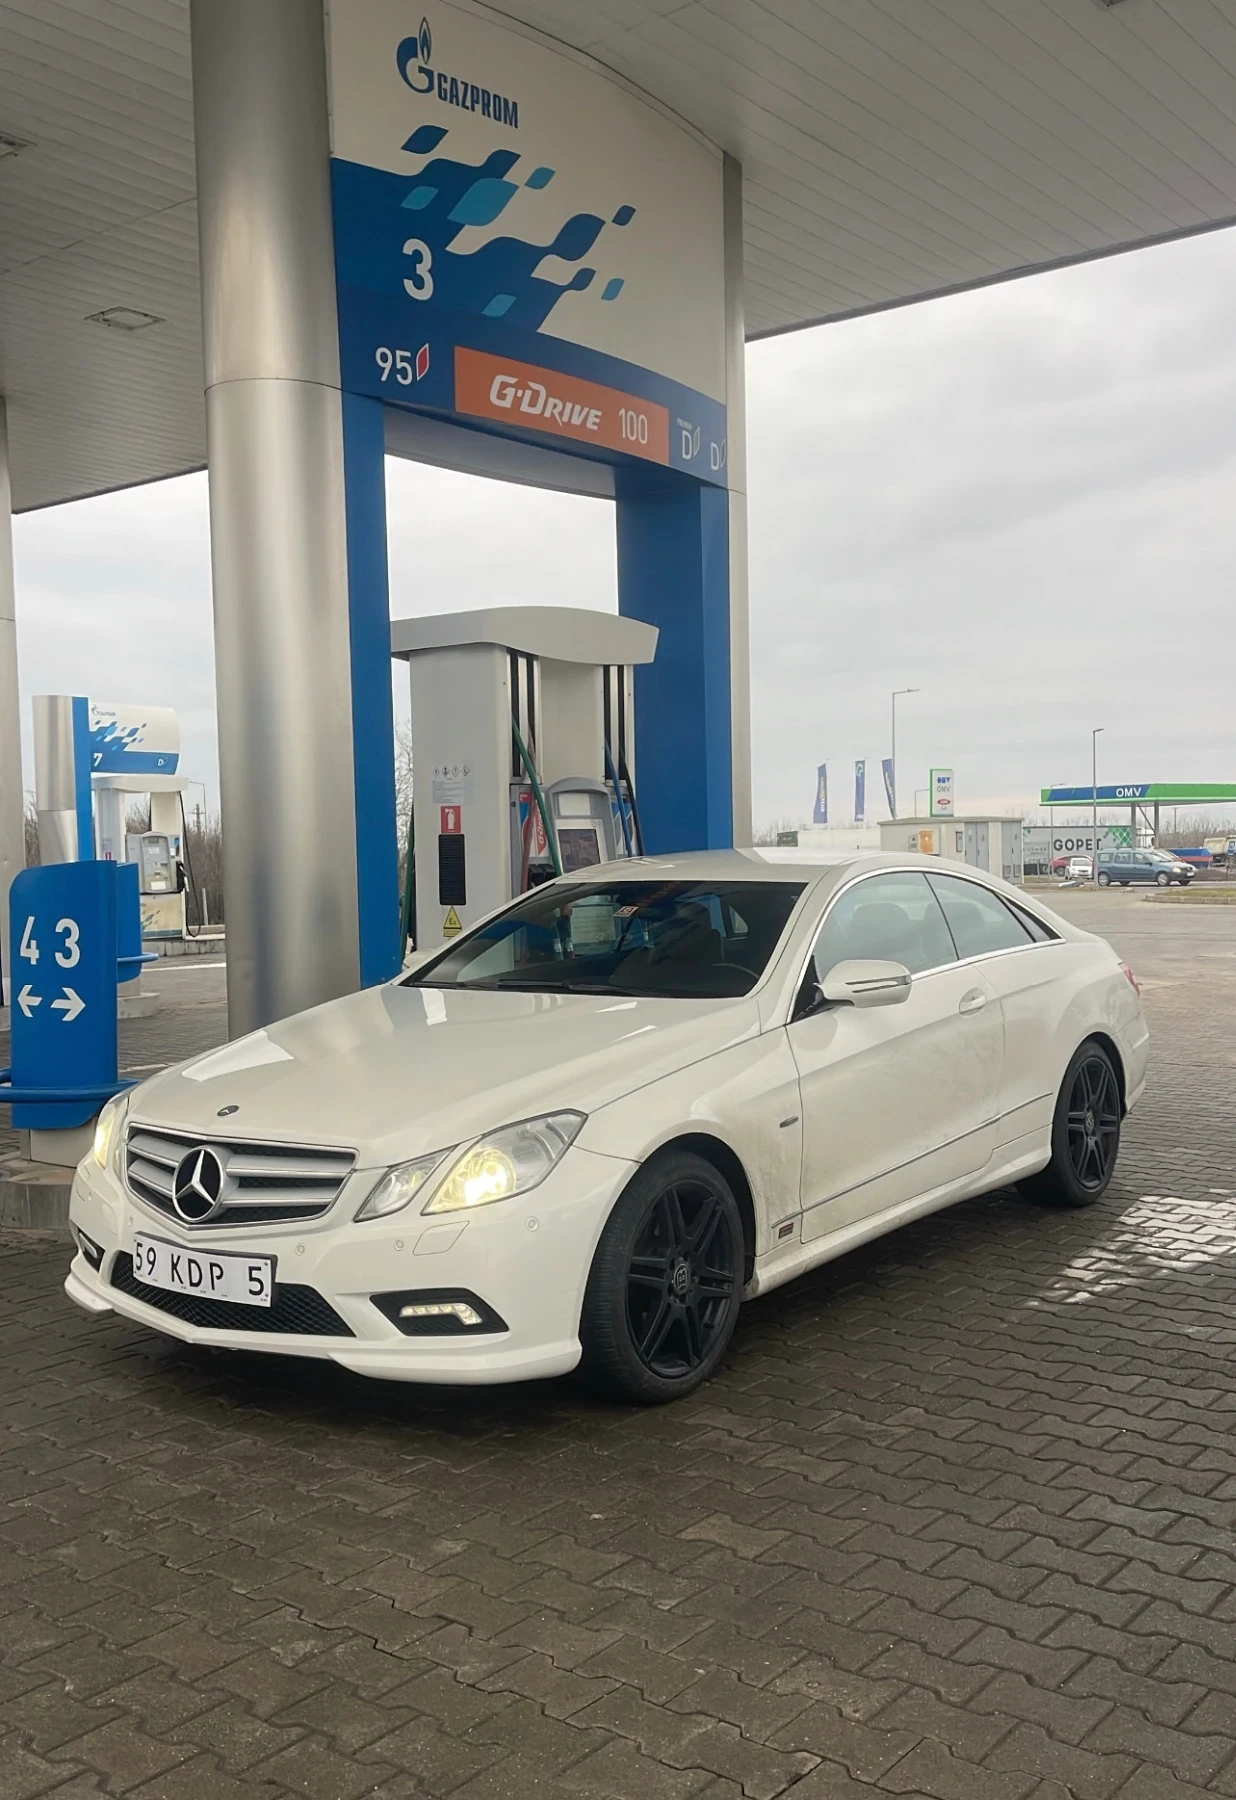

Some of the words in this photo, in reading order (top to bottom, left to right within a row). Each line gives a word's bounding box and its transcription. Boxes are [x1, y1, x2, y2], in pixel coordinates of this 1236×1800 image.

[437, 72, 518, 129] GAZPROM
[402, 238, 434, 300] 3
[375, 347, 412, 385] 95
[618, 407, 648, 445] 100
[682, 429, 692, 460] D
[710, 442, 719, 471] D
[93, 752, 103, 767] 7
[936, 785, 951, 793] OMV
[1115, 787, 1142, 798] OMV
[20, 916, 39, 965] 4
[54, 918, 80, 968] 3
[135, 1242, 157, 1275] 59
[171, 1253, 224, 1290] KDP
[248, 1266, 265, 1296] 5
